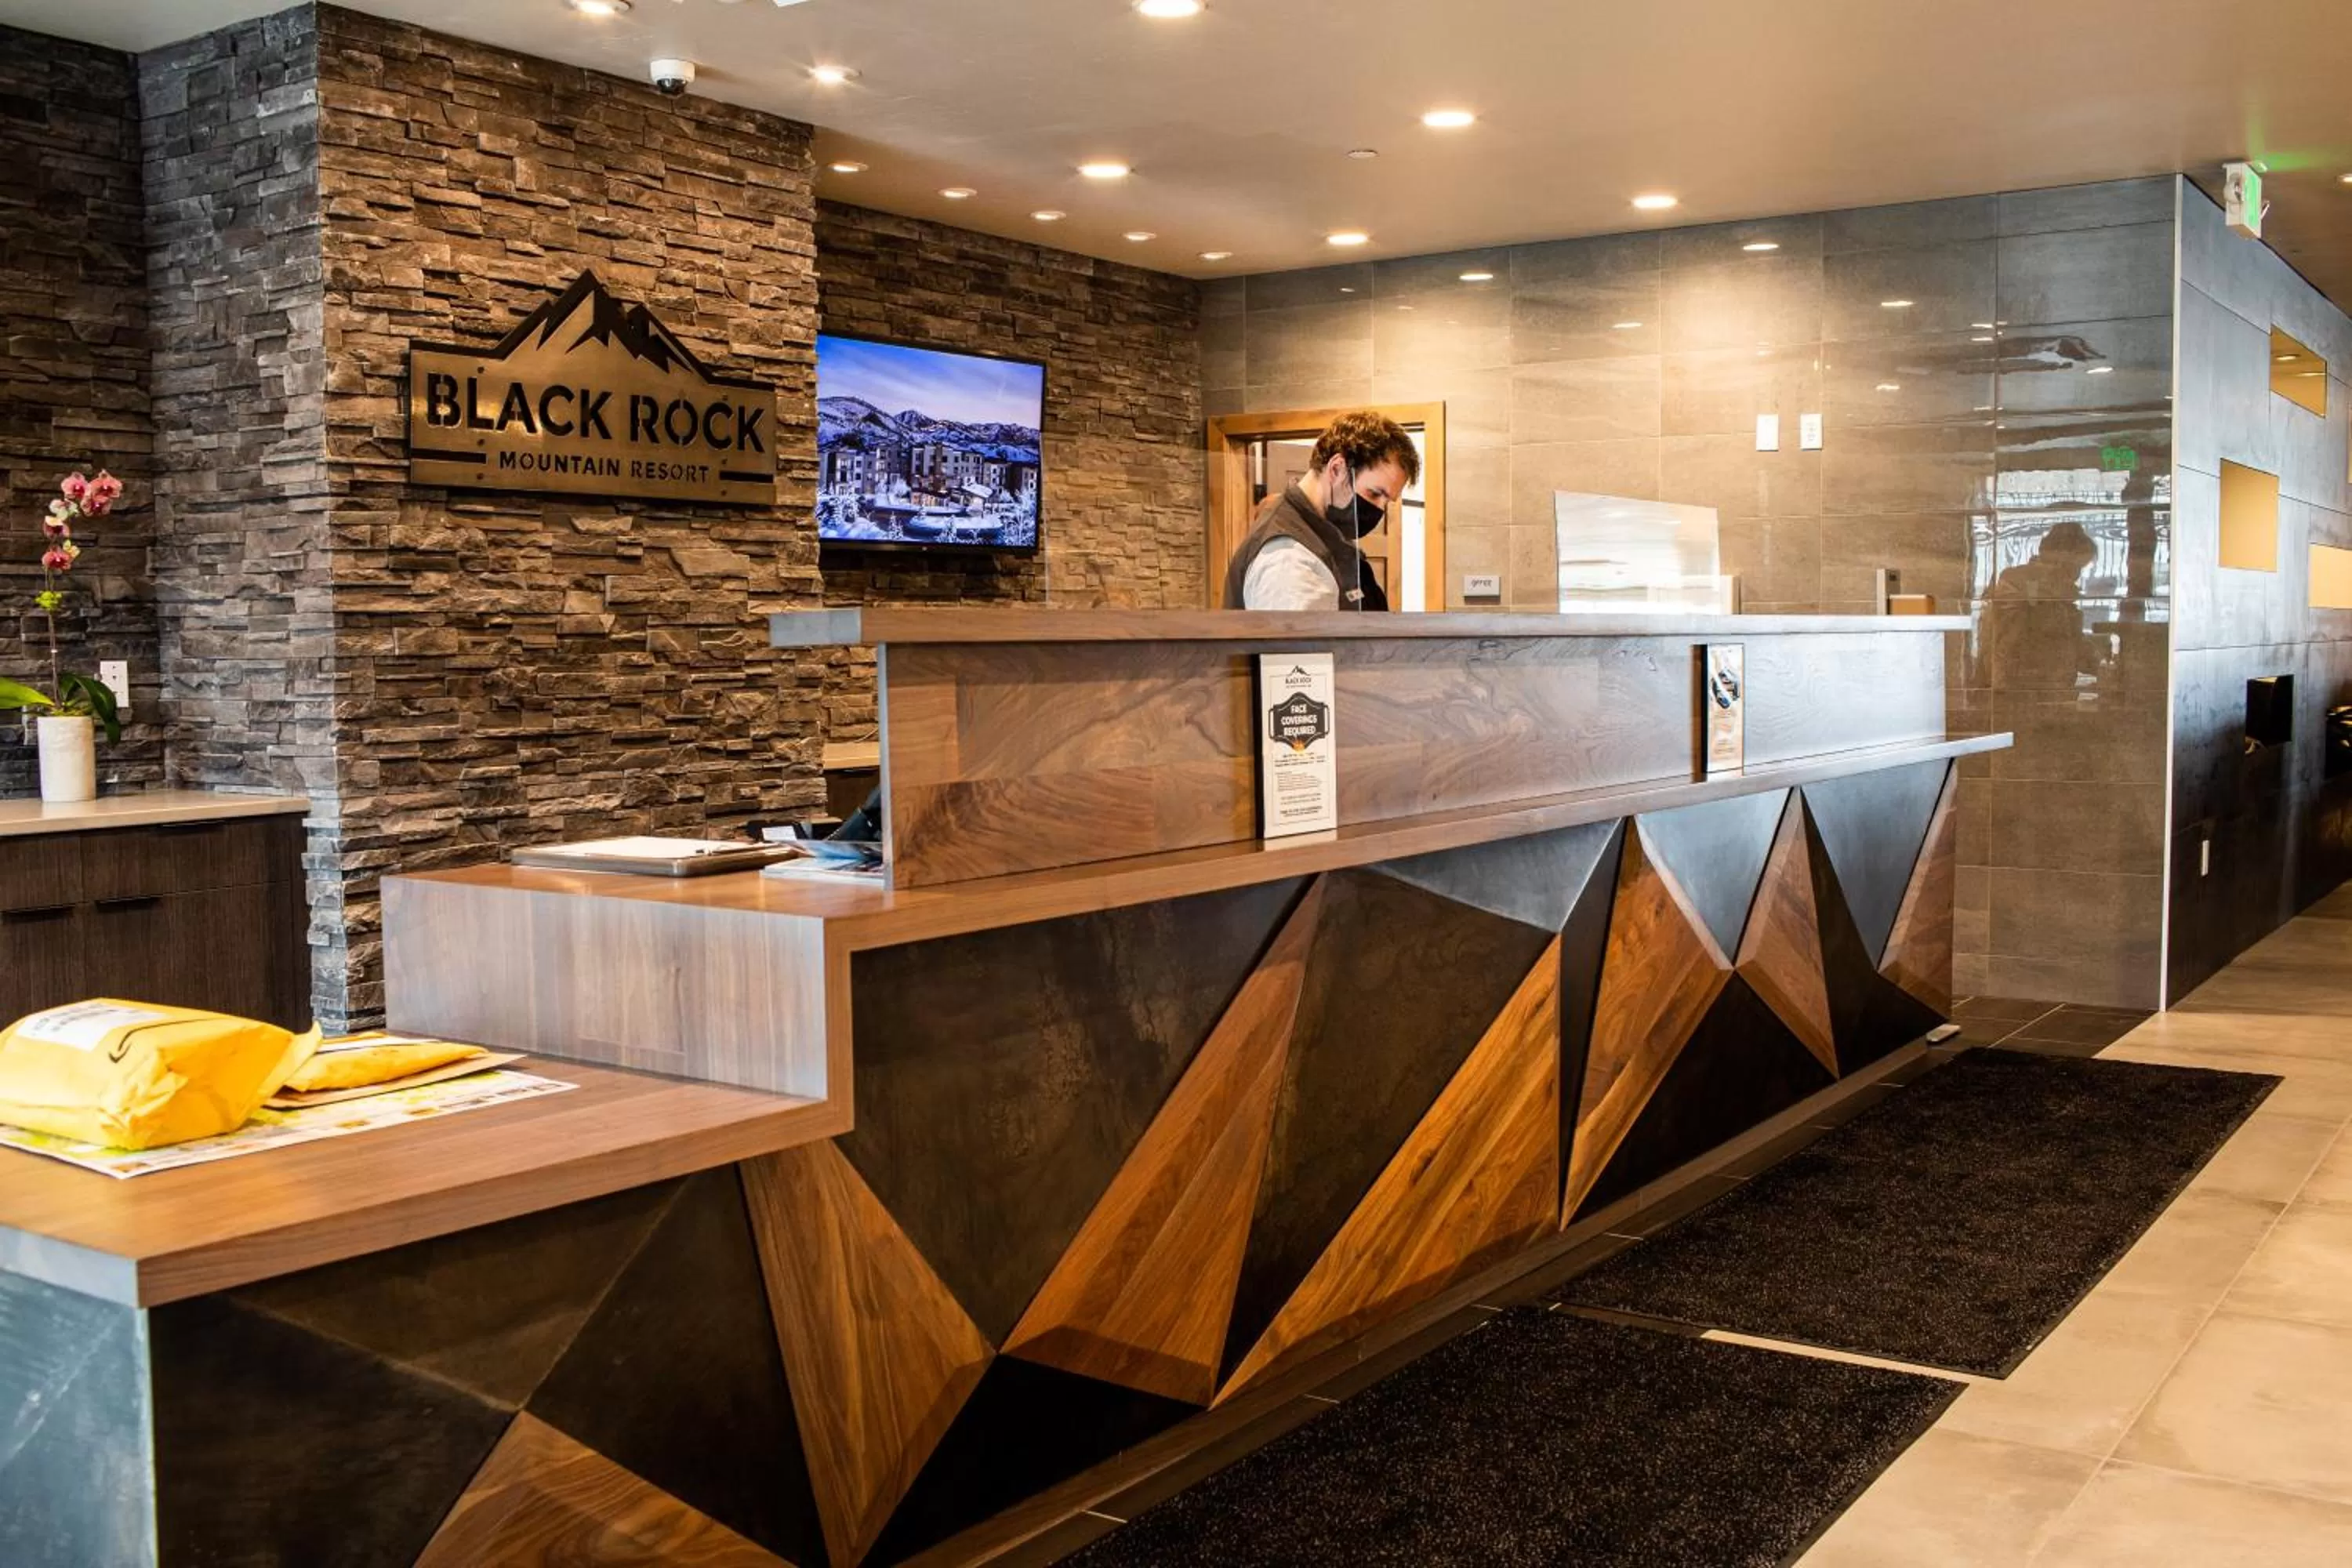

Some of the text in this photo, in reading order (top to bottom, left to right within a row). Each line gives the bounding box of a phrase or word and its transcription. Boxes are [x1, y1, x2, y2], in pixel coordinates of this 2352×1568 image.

[427, 372, 765, 453] BLACK ROCK
[499, 451, 710, 483] MOUNTAIN RESORT
[1290, 704, 1307, 714] FACE
[1280, 714, 1317, 726] COVERINGS
[1283, 725, 1316, 737] REQUIRED
